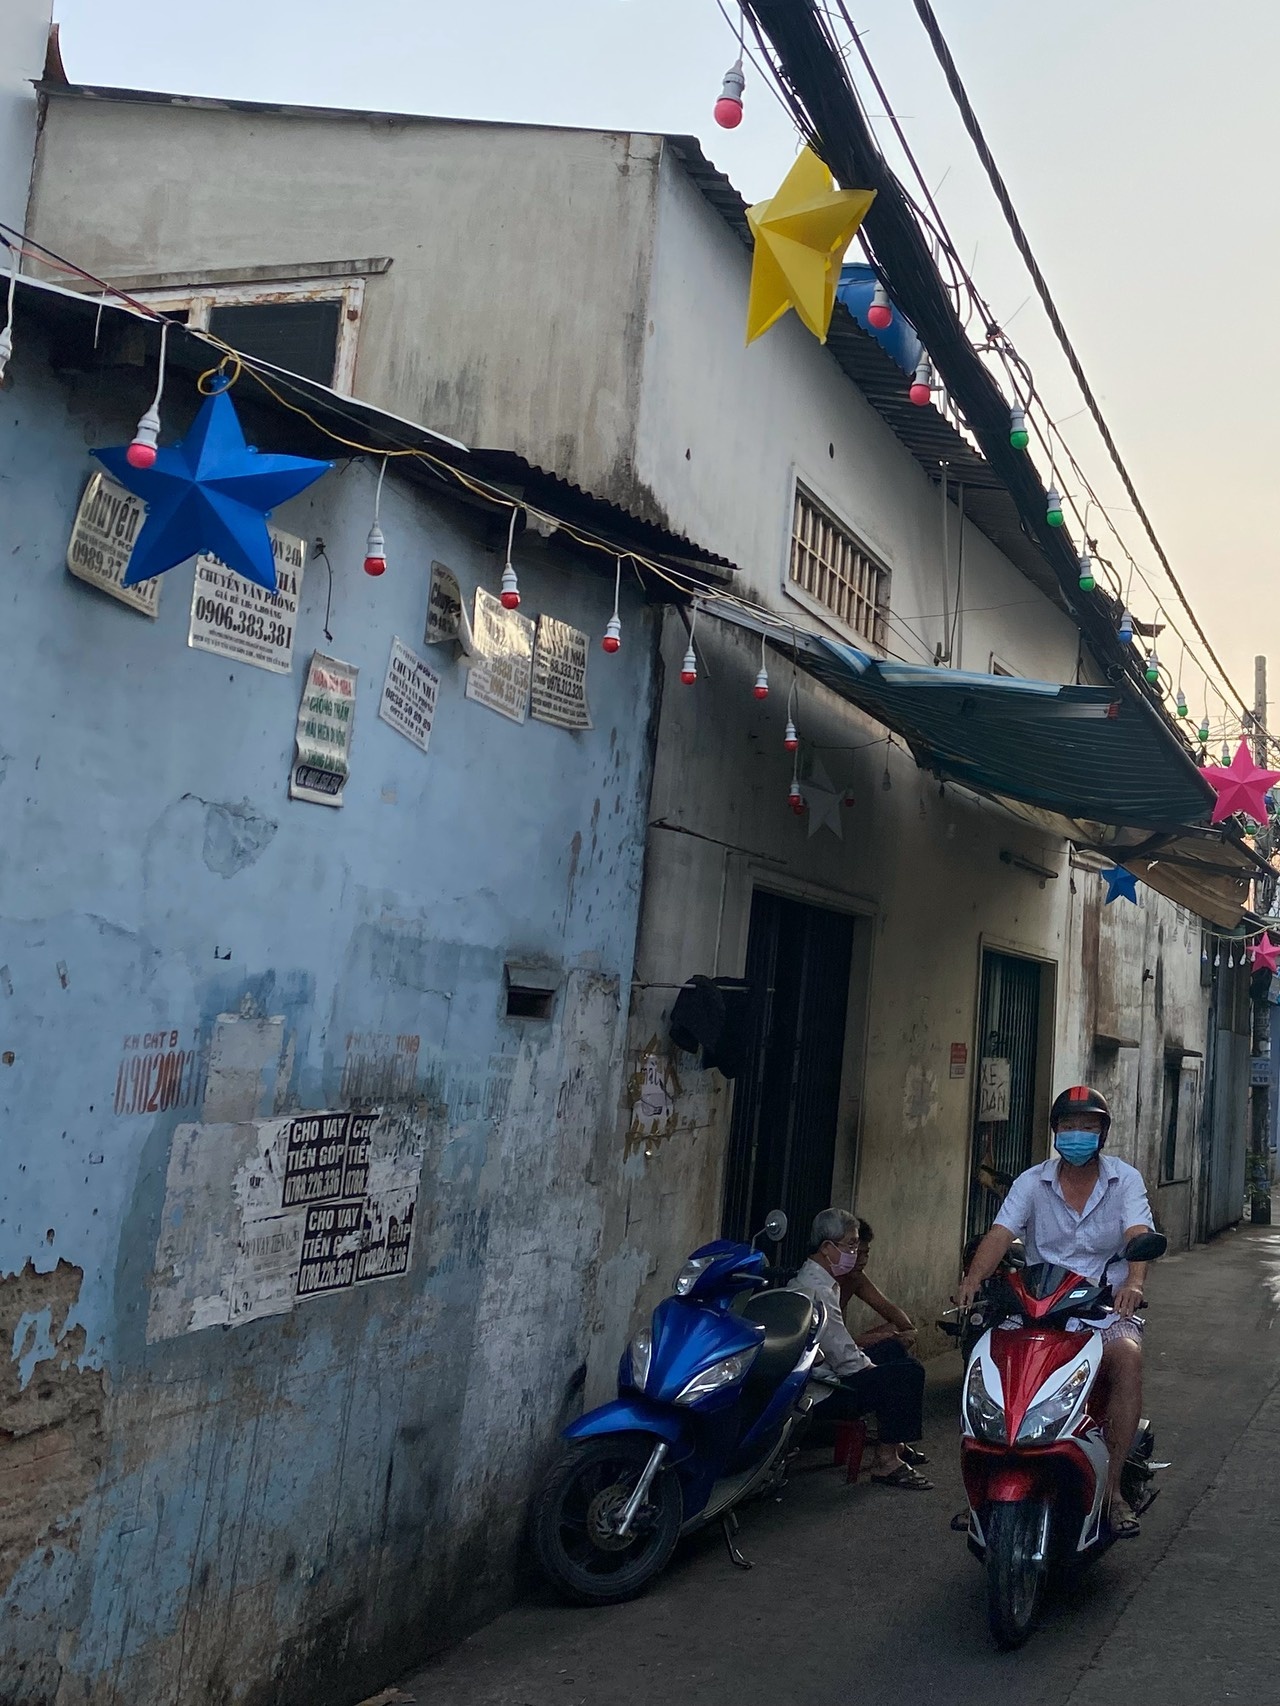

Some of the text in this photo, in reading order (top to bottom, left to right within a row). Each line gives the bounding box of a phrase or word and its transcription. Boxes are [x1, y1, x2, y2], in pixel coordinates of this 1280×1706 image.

[200, 567, 240, 592] CHUYỂN
[242, 581, 262, 601] VĂN
[196, 595, 292, 649] 0906.383.381
[981, 1064, 997, 1086] XE
[292, 1118, 346, 1143] CHO VAY
[288, 1141, 345, 1172] TIỀN GÓP
[308, 1207, 360, 1232] CHO VAY
[303, 1231, 331, 1260] TIỀN
